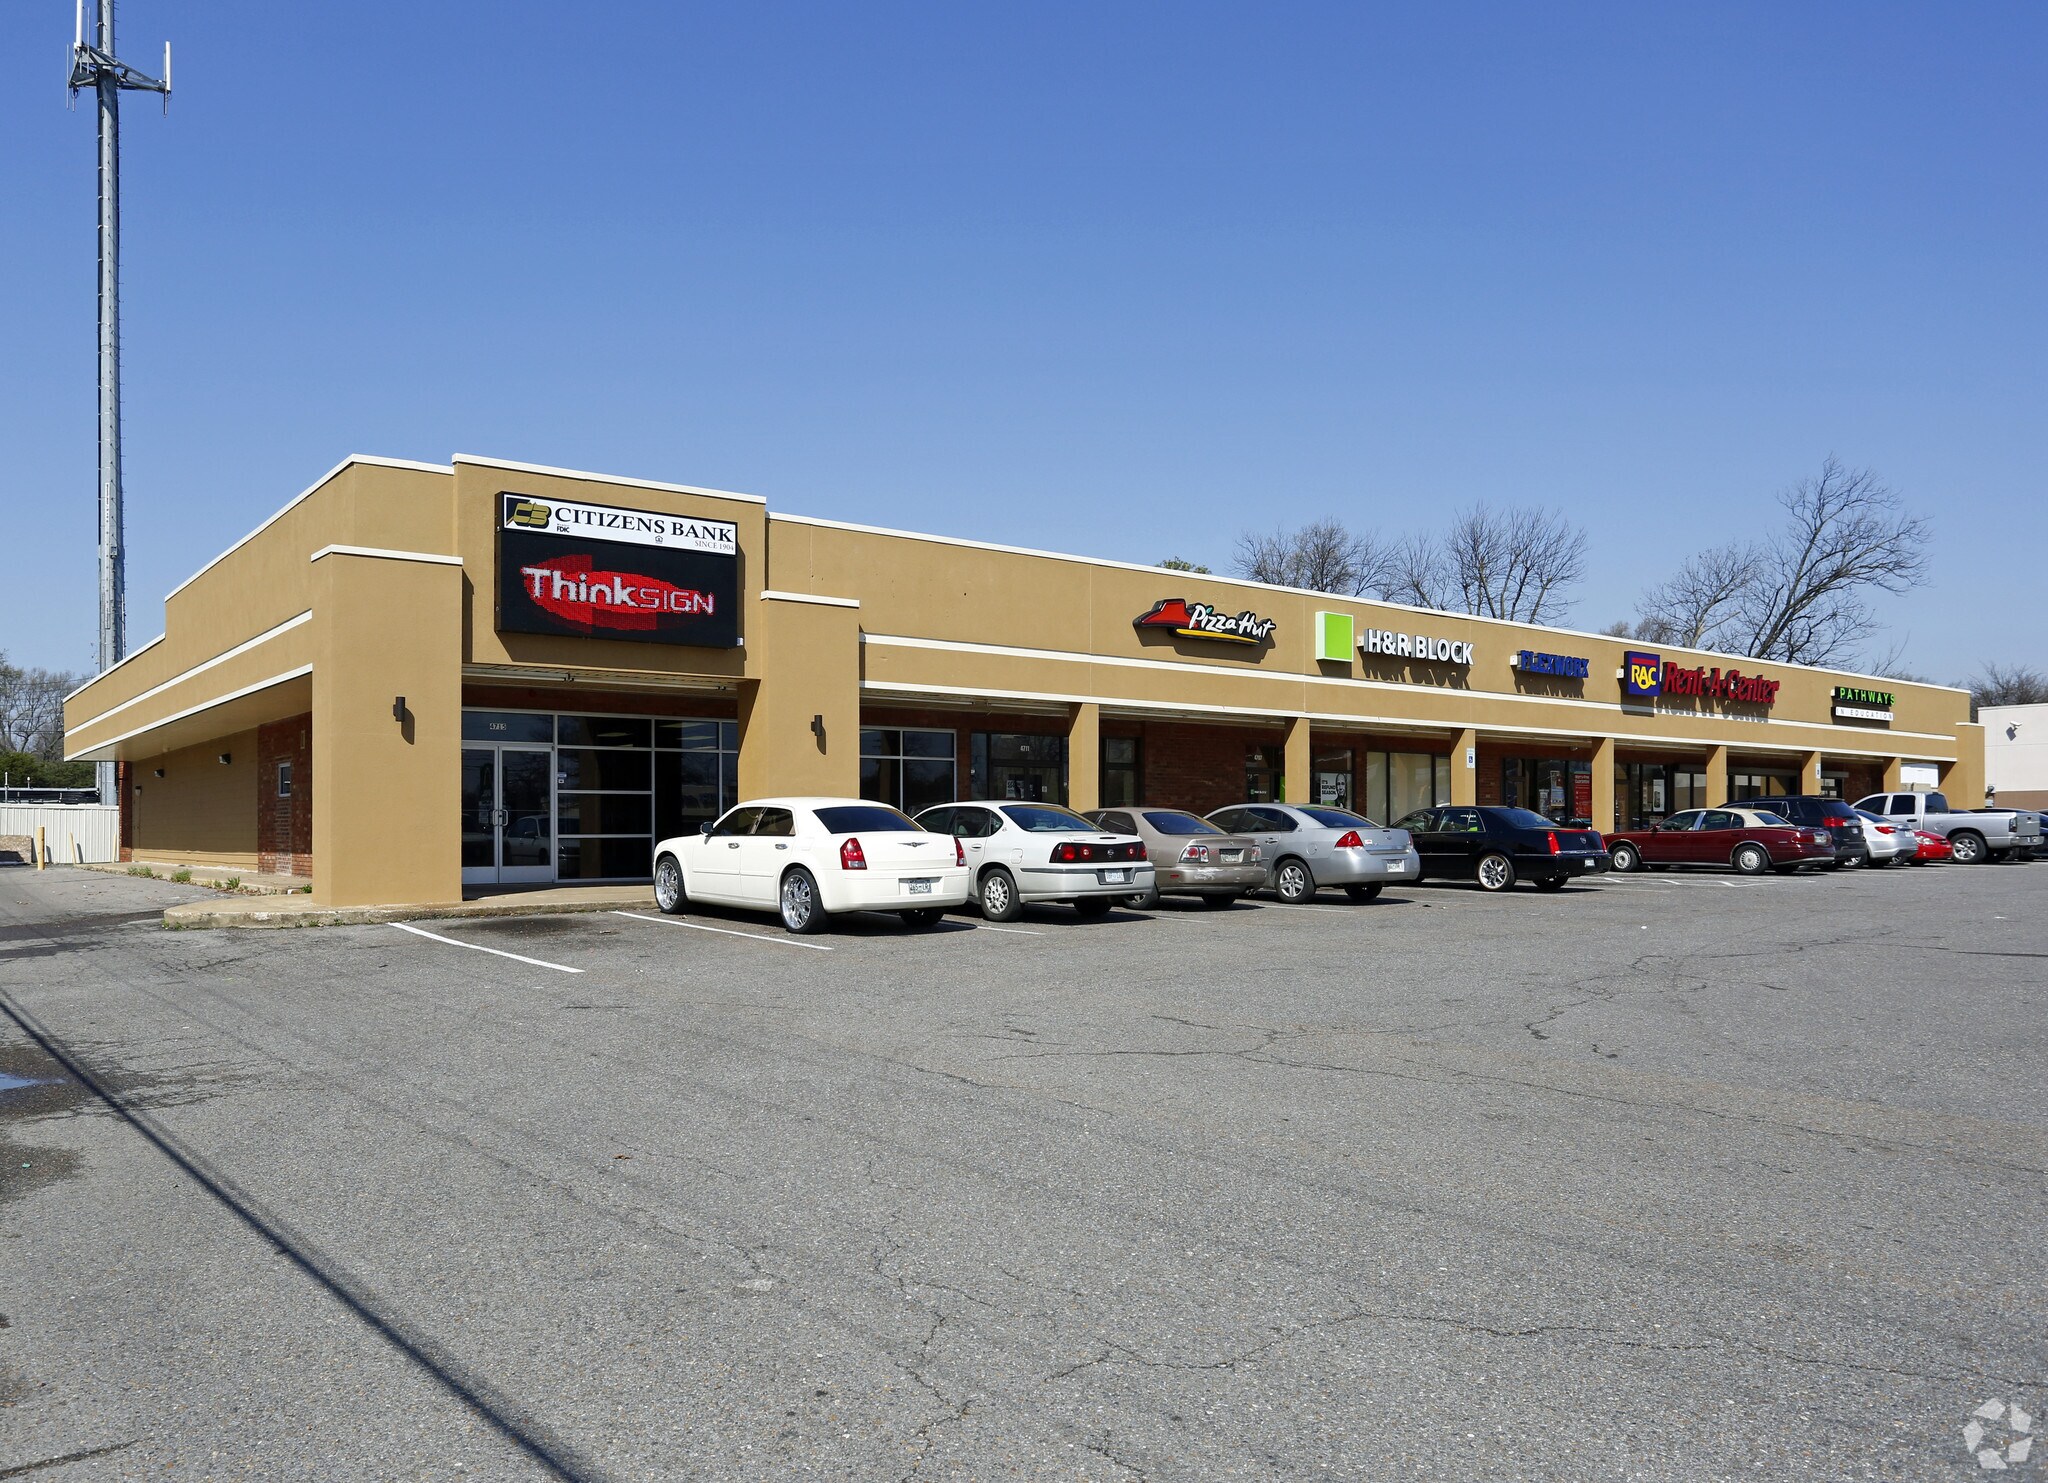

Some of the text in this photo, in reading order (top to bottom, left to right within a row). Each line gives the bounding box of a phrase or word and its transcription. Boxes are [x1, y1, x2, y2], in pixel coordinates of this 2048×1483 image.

[555, 507, 734, 543] CITIZENS BANK
[556, 526, 570, 536] FDIC
[695, 540, 734, 551] SINCE 1904
[1189, 605, 1276, 638] Pizza Hut
[1366, 628, 1475, 665] H&R BLOCK
[1631, 664, 1657, 689] RAC
[1840, 687, 1895, 705] PATHWAYS
[1850, 709, 1893, 719] EDUCATION
